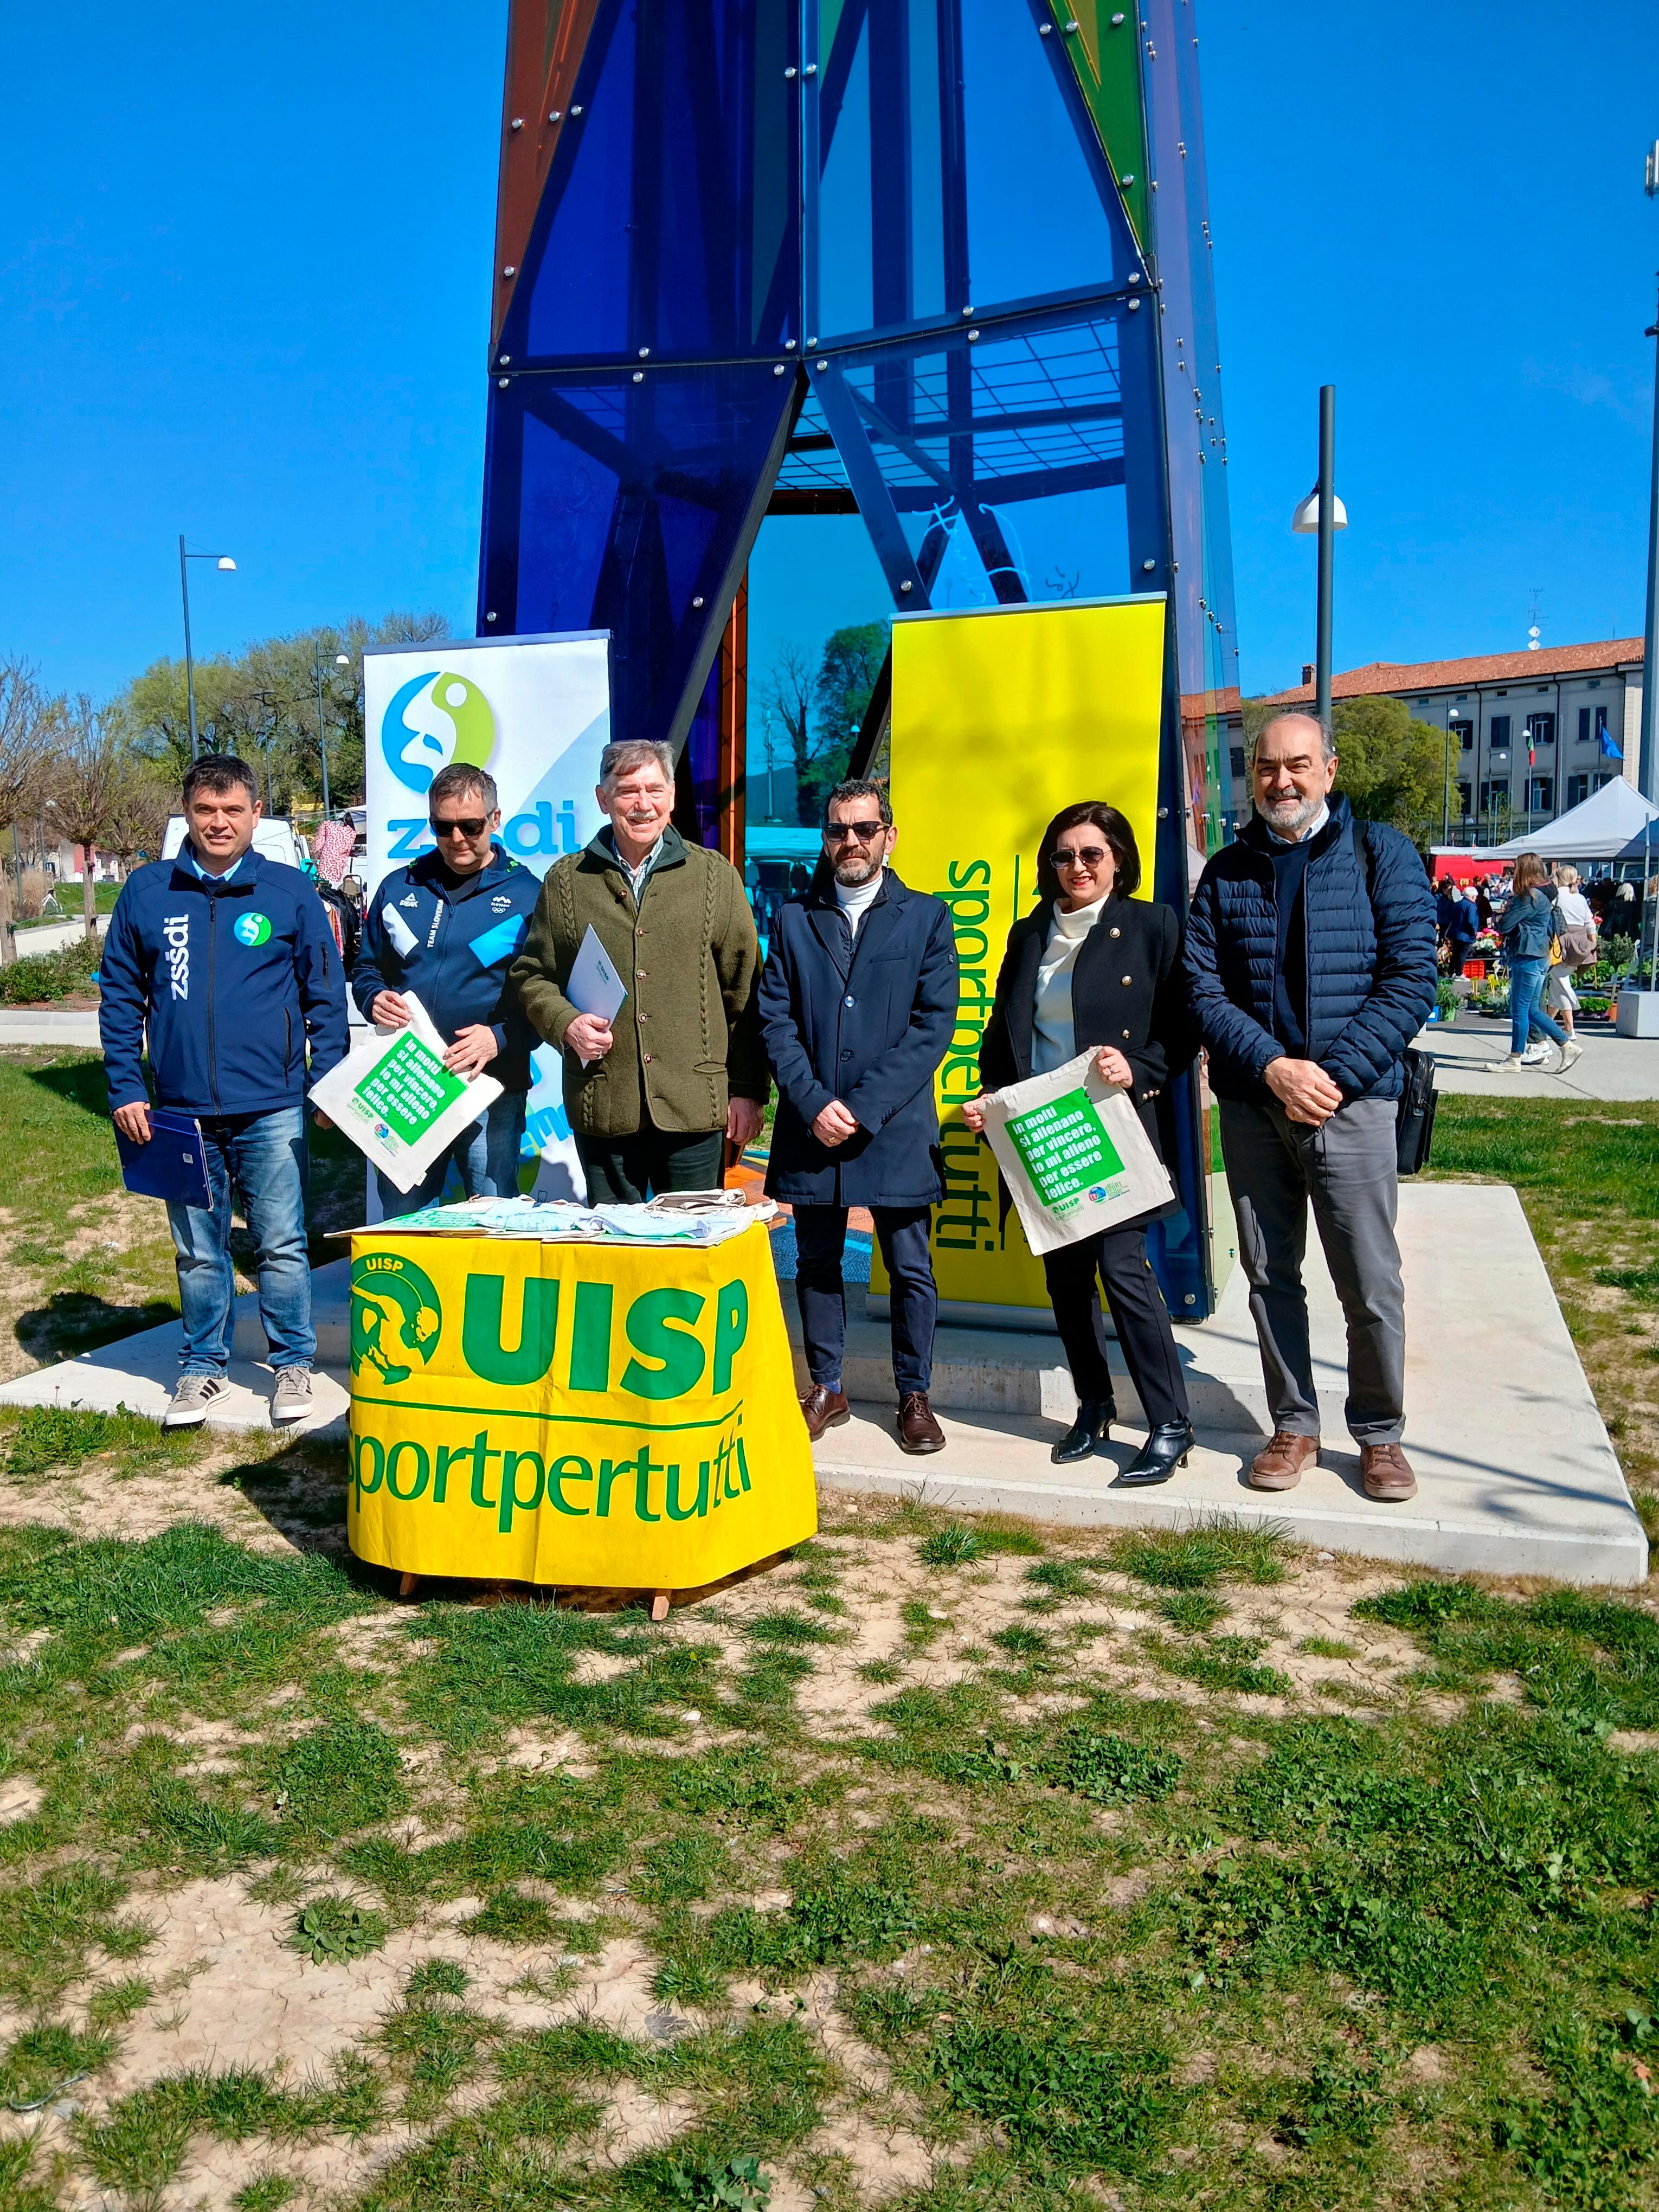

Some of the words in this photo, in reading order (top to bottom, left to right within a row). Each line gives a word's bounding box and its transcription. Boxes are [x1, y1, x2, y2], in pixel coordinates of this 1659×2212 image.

[388, 800, 581, 858] zdi
[399, 899, 419, 908] PEAK
[427, 928, 437, 948] TEAM
[397, 1050, 409, 1062] si
[406, 1059, 446, 1098] allenano
[414, 1049, 441, 1076] molti
[362, 1086, 389, 1117] felice.
[370, 1078, 389, 1095] per
[386, 1093, 417, 1125] essere
[387, 1059, 406, 1077] per
[403, 1074, 438, 1112] vincere,
[389, 1078, 404, 1093] mi
[400, 1090, 430, 1119] alleno
[358, 1103, 374, 1118] UISP
[1012, 1123, 1025, 1135] in
[1025, 1105, 1057, 1129] molti
[1019, 1134, 1031, 1148] si
[1031, 1110, 1084, 1143] allenano
[1026, 1144, 1045, 1162] per
[1046, 1122, 1096, 1151] vincere,
[1031, 1162, 1045, 1174] io
[1044, 1151, 1063, 1169] mi
[1062, 1135, 1101, 1160] alleno
[1039, 1170, 1059, 1188] per
[1060, 1150, 1102, 1177] essere
[1045, 1178, 1084, 1200] felice.
[1059, 1197, 1079, 1212] UISP
[366, 1257, 403, 1271] UISP
[461, 1272, 749, 1400] UISP
[349, 1413, 751, 1533] portpertutti
